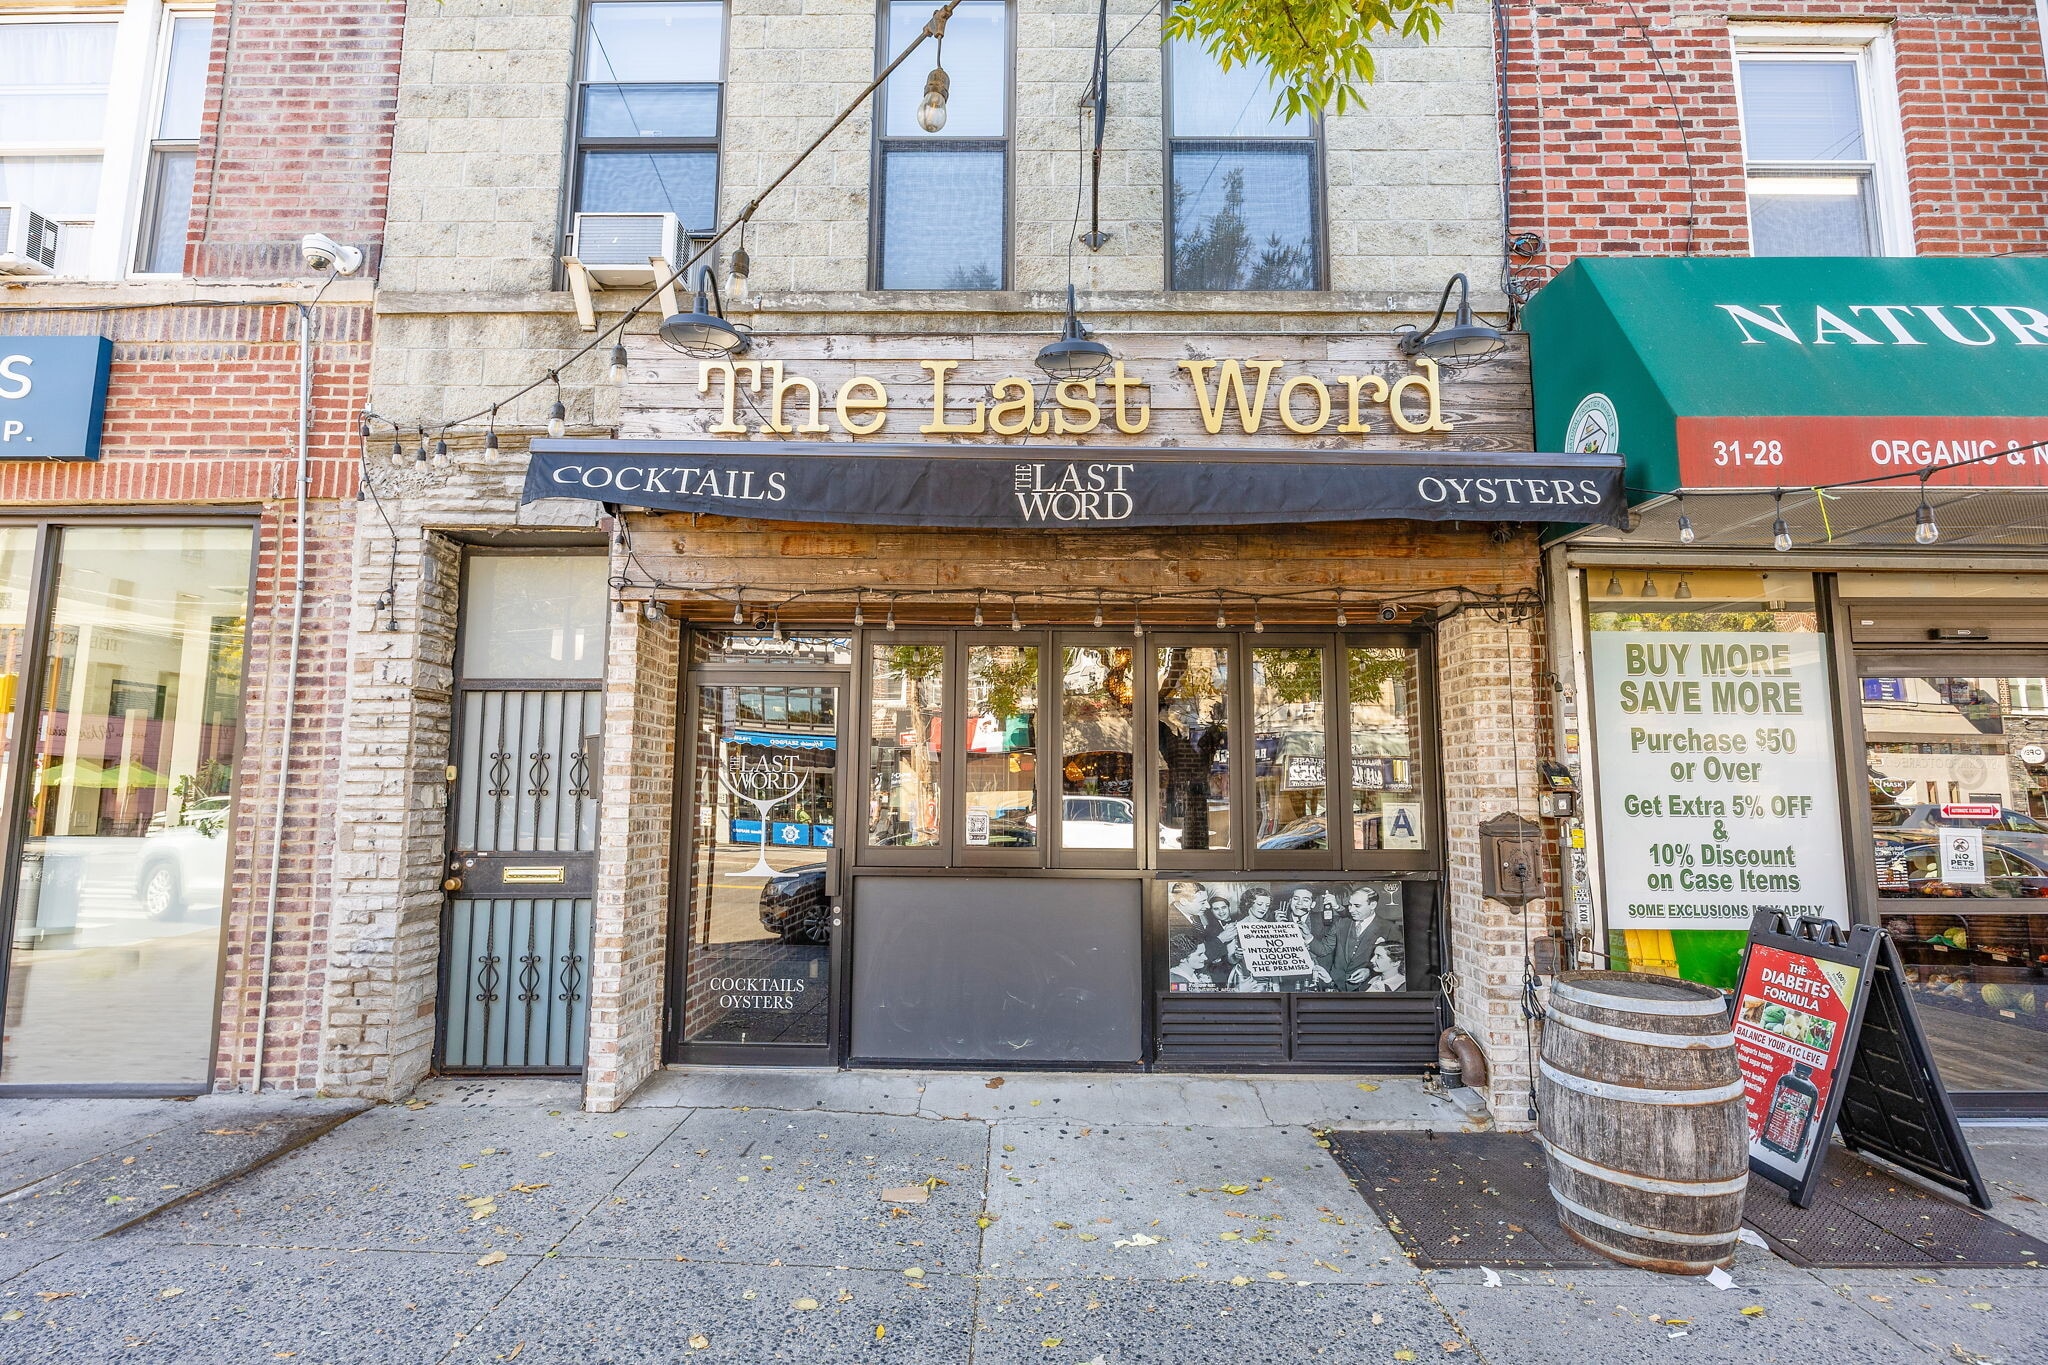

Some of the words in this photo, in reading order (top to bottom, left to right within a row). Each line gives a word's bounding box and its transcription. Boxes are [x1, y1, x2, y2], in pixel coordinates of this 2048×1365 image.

[697, 359, 888, 435] The
[919, 359, 1151, 435] Last
[1178, 358, 1454, 435] Word
[1712, 439, 1784, 466] 31-28
[1870, 439, 1999, 466] ORGANIC
[2006, 439, 2027, 466] &
[552, 465, 787, 502] COCKTAILS
[1014, 463, 1032, 491] THE
[1033, 463, 1135, 493] LAST
[1418, 475, 1602, 506] OYSTERS
[1014, 491, 1134, 522] WORD
[1625, 643, 1691, 677] BUY
[1701, 644, 1792, 678] MORE
[1619, 680, 1703, 714] SAVE
[1711, 681, 1804, 715] MORE
[1630, 727, 1748, 753] Purchase
[1755, 727, 1797, 754] $50
[730, 755, 740, 772] THE
[740, 754, 800, 773] LAST
[1670, 761, 1697, 782] or
[1703, 755, 1762, 782] Over
[730, 772, 799, 790] WORD
[1624, 794, 1663, 817] Get
[1668, 794, 1726, 817] Extra
[1731, 794, 1765, 818] 5%
[1770, 795, 1814, 818] OFF
[1389, 808, 1415, 837] A
[1712, 819, 1729, 842] &
[1649, 843, 1695, 867] 10%
[1700, 843, 1797, 867] Discount
[1951, 859, 1975, 867] PETS
[1647, 872, 1675, 891] on
[1679, 868, 1734, 892] Case
[1739, 868, 1801, 892] Items
[1627, 903, 1665, 918] SOME
[1667, 903, 1750, 918] EXCLUSIONS
[1783, 904, 1825, 917] APPLY
[1248, 946, 1304, 954] INTOXICATING
[1265, 939, 1284, 947] NO
[1789, 962, 1808, 976] THE
[710, 977, 805, 992] COCKTAILS
[1761, 967, 1832, 999] DIABETES
[719, 994, 795, 1010] OYSTERS
[1763, 985, 1820, 1012] FORMULA
[1736, 1026, 1767, 1045] BALANCE
[1767, 1036, 1787, 1051] YOUR
[1786, 1044, 1801, 1057] A1C
[1740, 1043, 1758, 1056] Supports
